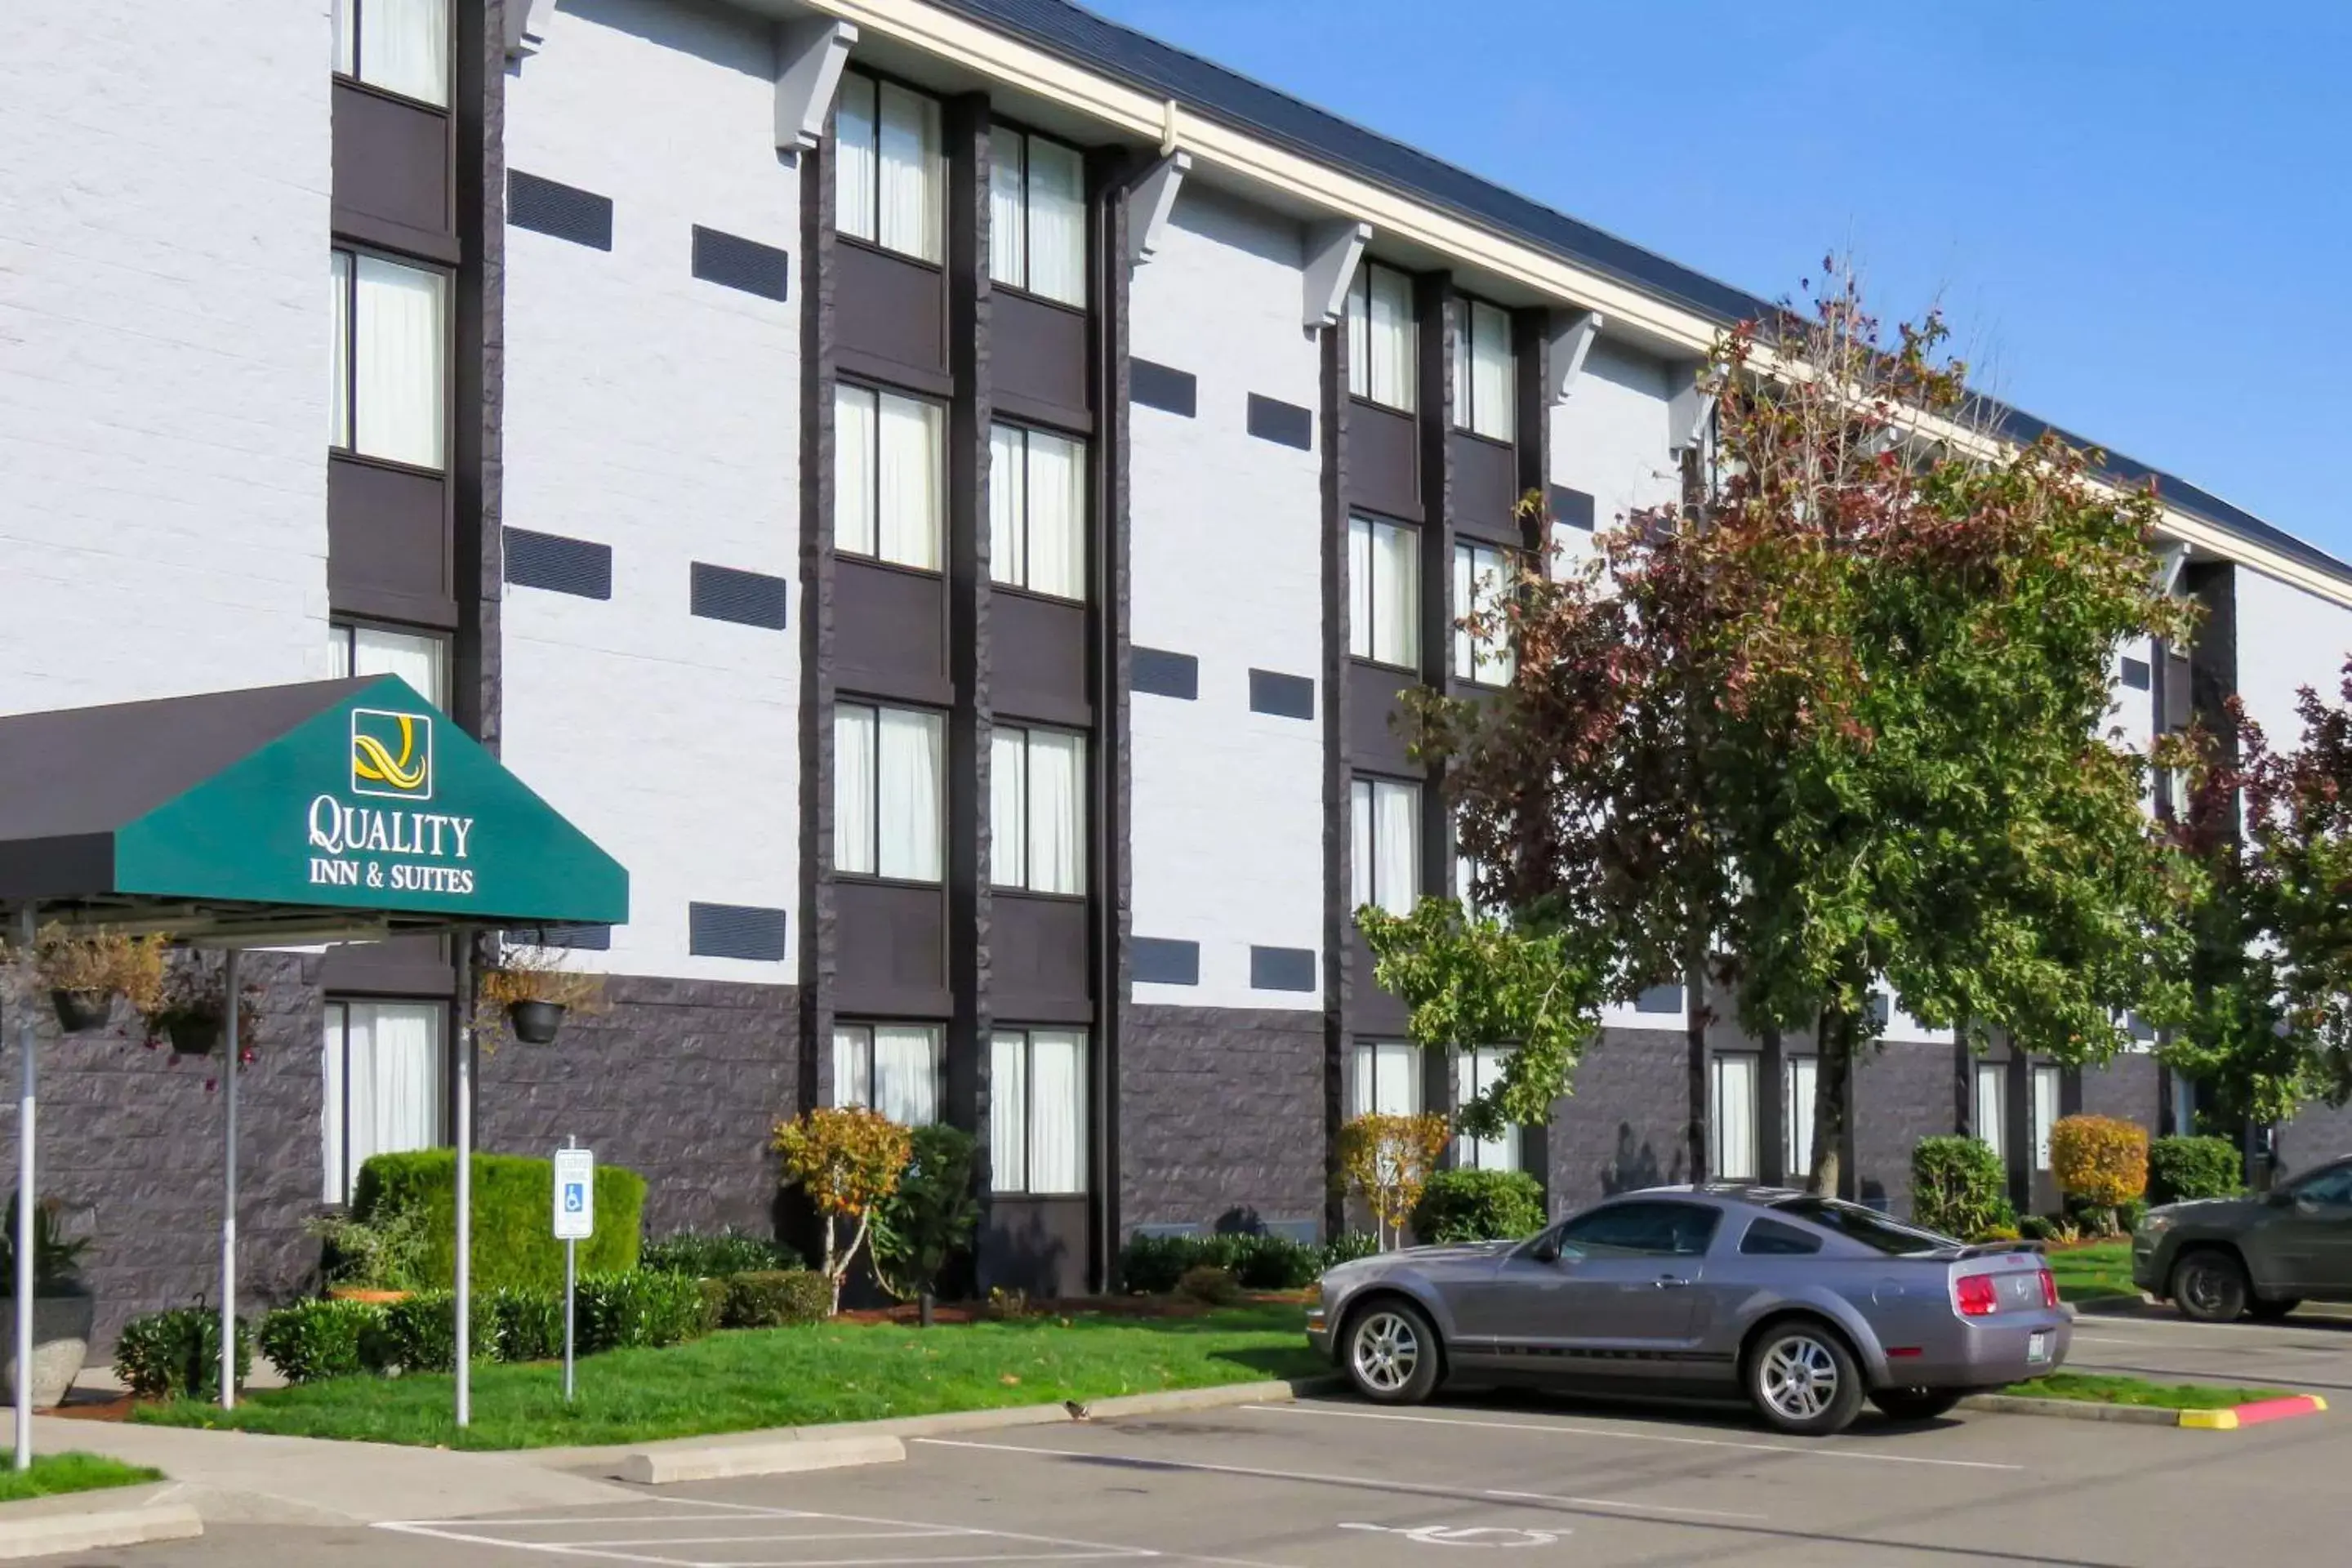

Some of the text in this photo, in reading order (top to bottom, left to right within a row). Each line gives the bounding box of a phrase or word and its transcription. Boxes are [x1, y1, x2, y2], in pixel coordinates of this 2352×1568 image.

[309, 795, 473, 858] QUALITY
[310, 858, 474, 893] INN & SUITES
